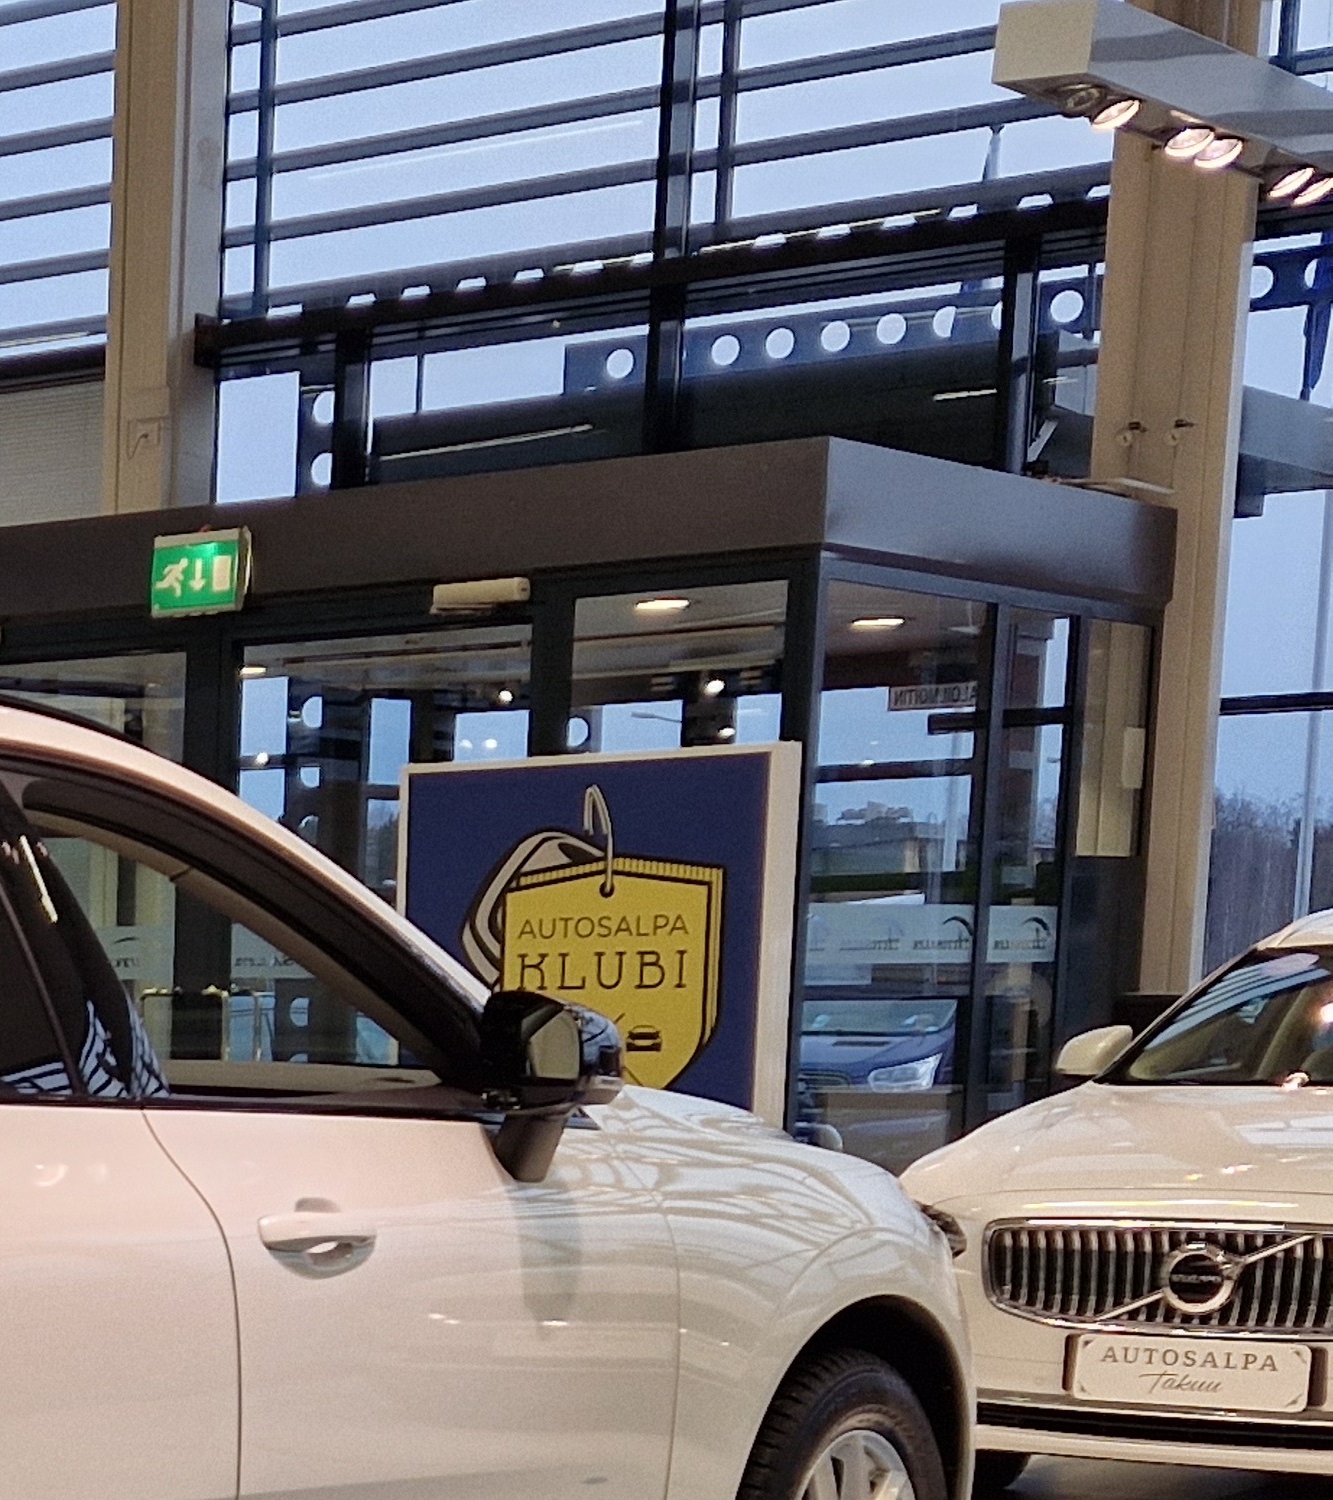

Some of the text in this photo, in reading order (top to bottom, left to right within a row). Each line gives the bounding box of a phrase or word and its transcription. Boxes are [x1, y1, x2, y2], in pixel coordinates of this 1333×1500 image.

[518, 914, 689, 940] AUTOSALPA
[516, 949, 688, 991] KLUBI
[1100, 1345, 1279, 1372] AUTOSALPA
[1138, 1371, 1223, 1394] Takuu
